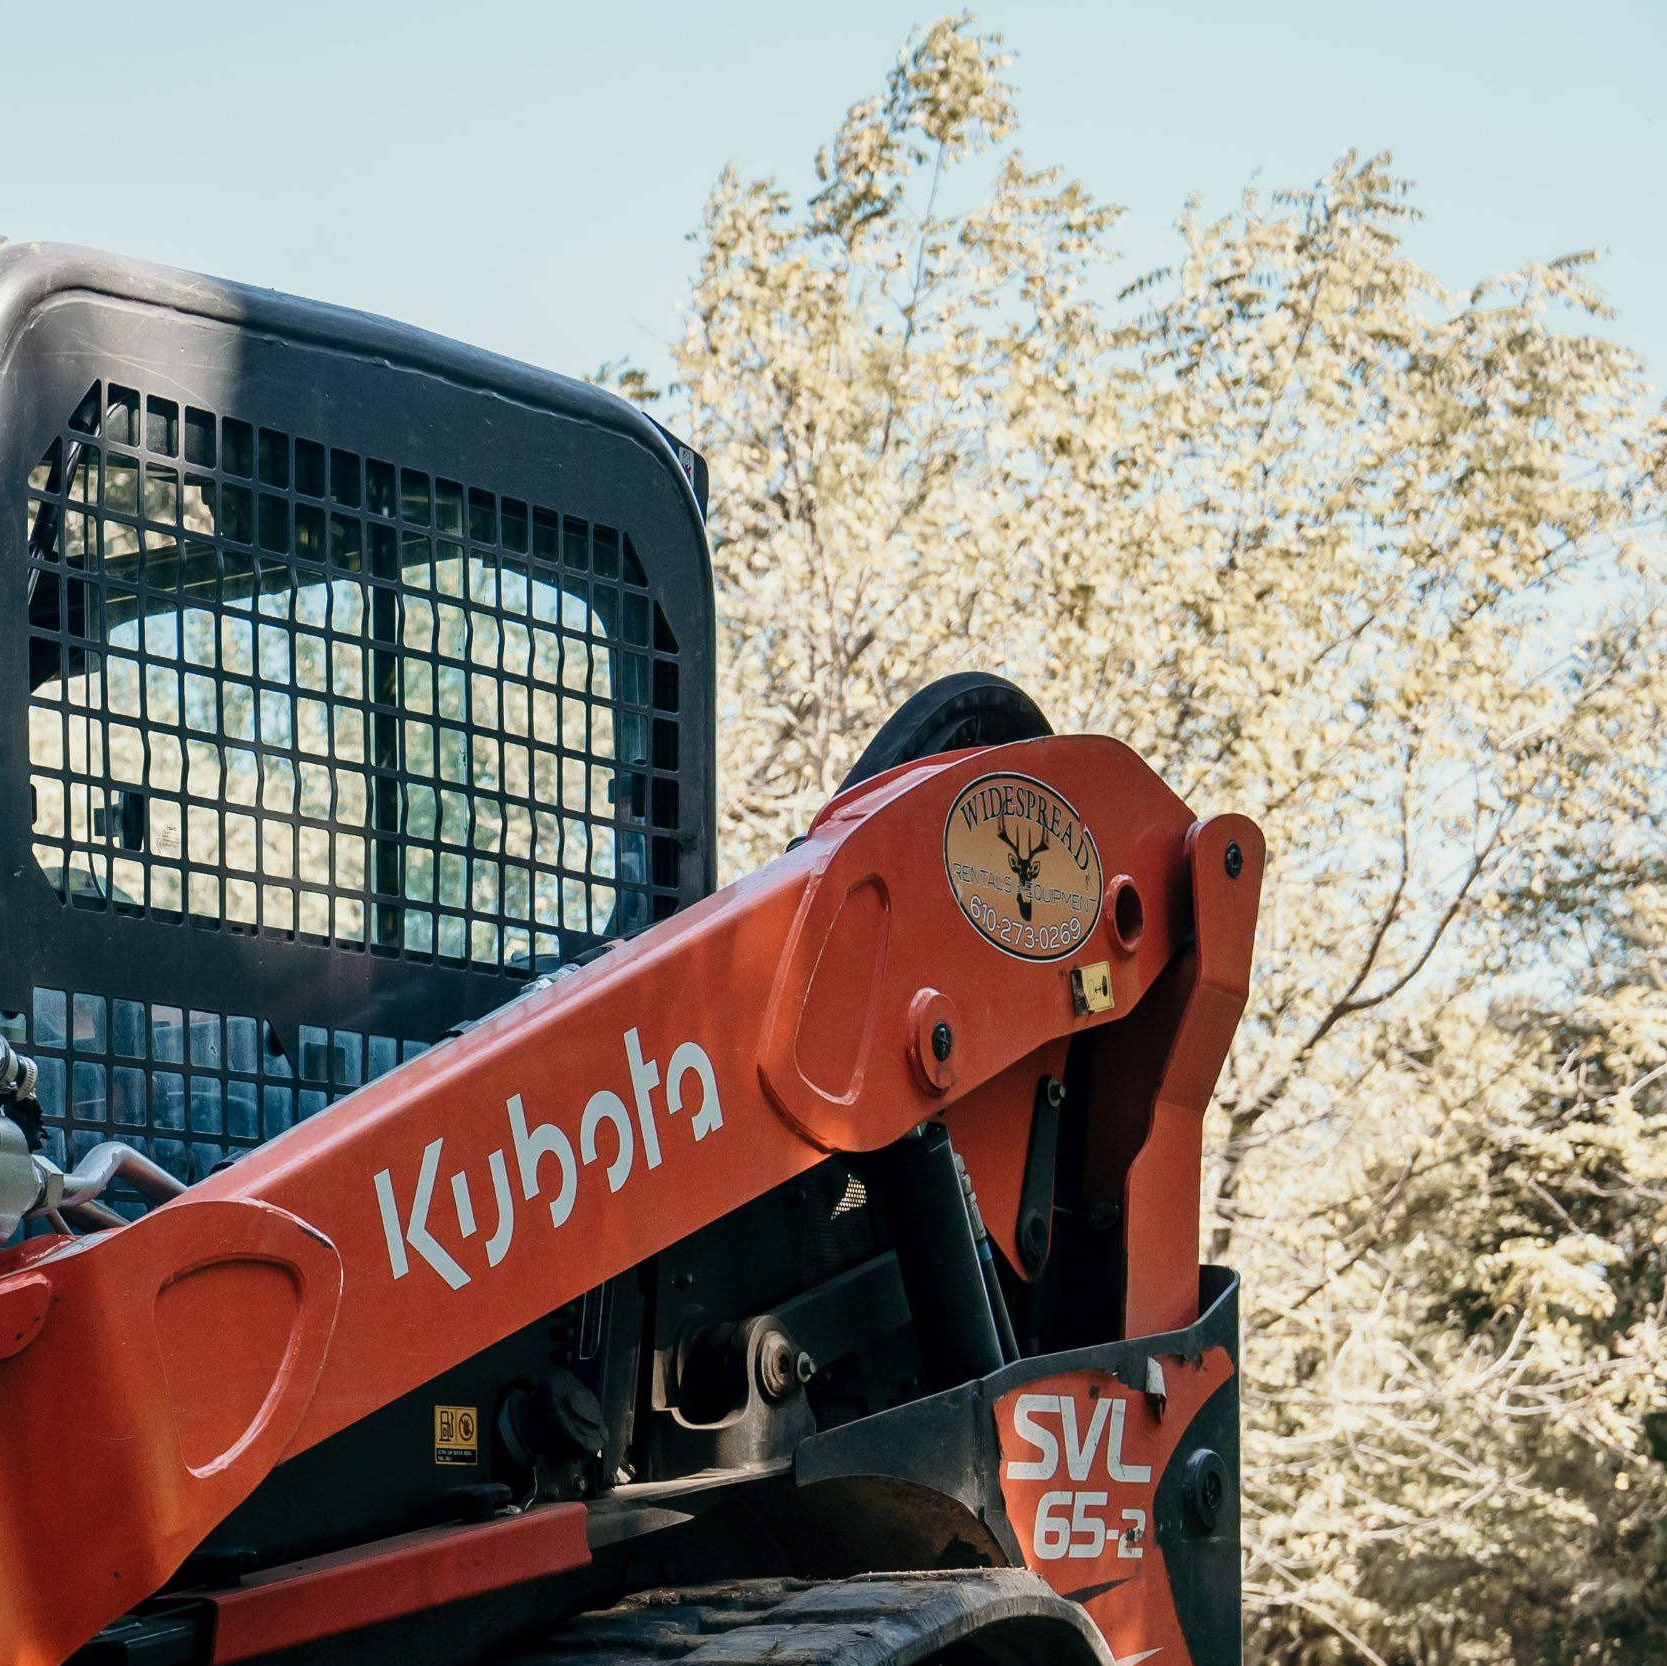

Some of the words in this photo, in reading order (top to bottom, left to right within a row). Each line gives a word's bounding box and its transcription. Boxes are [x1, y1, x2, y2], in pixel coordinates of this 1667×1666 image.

[960, 785, 1089, 870] WIDESPREAD
[953, 862, 1013, 894] RENTALS
[1024, 879, 1098, 914] EQUIPMENT
[969, 895, 1082, 950] 610-273-0269
[373, 1026, 724, 1291] Kubota
[1006, 1393, 1152, 1483] SVL
[1033, 1491, 1147, 1560] 65-2
